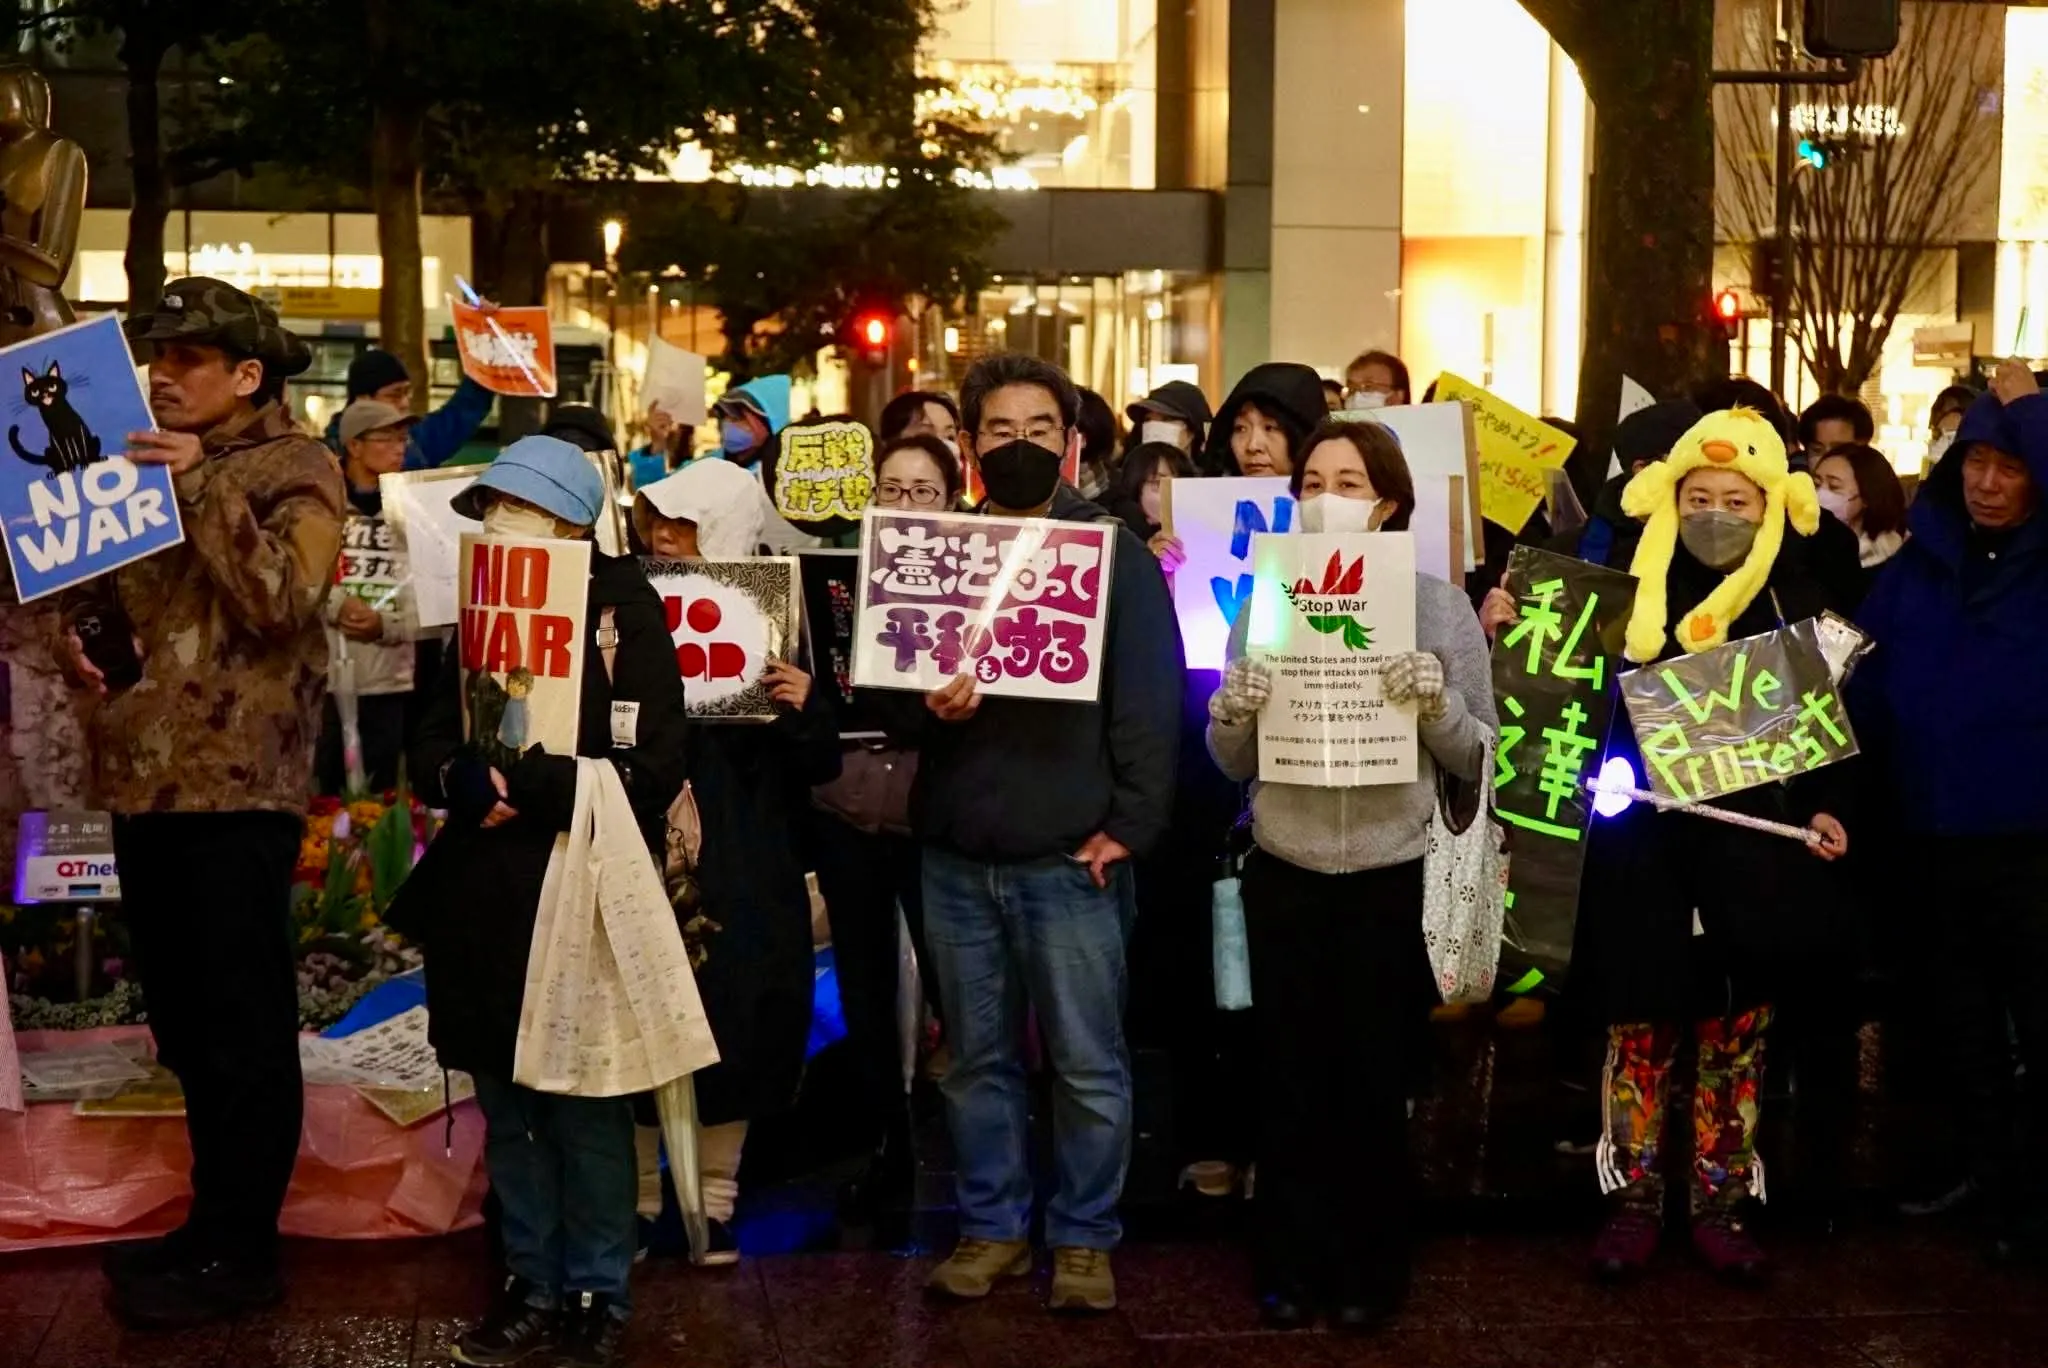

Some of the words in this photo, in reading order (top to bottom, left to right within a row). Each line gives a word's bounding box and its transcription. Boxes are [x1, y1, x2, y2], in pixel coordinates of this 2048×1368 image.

[785, 429, 867, 472] 反戦
[28, 454, 139, 528] NO
[783, 473, 872, 512] ガチ勢
[16, 487, 170, 573] WAR
[471, 543, 550, 610] NO
[870, 526, 1101, 602] 憲法守って
[1299, 599, 1334, 613] Stop
[1338, 599, 1368, 612] War
[460, 607, 574, 678] WAR
[875, 607, 1090, 684] 平和も守る
[1265, 654, 1280, 663] The
[1280, 654, 1308, 664] United
[1310, 654, 1338, 664] States
[1340, 654, 1357, 664] and
[1359, 654, 1383, 663] Israel
[1280, 668, 1298, 677] stop
[1300, 667, 1321, 677] their
[1325, 667, 1356, 677] attacks
[1289, 699, 1385, 710] アメリカイスラエルは
[1304, 682, 1363, 691] immediately.
[1660, 653, 1783, 725] We
[1640, 692, 1848, 805] Protest
